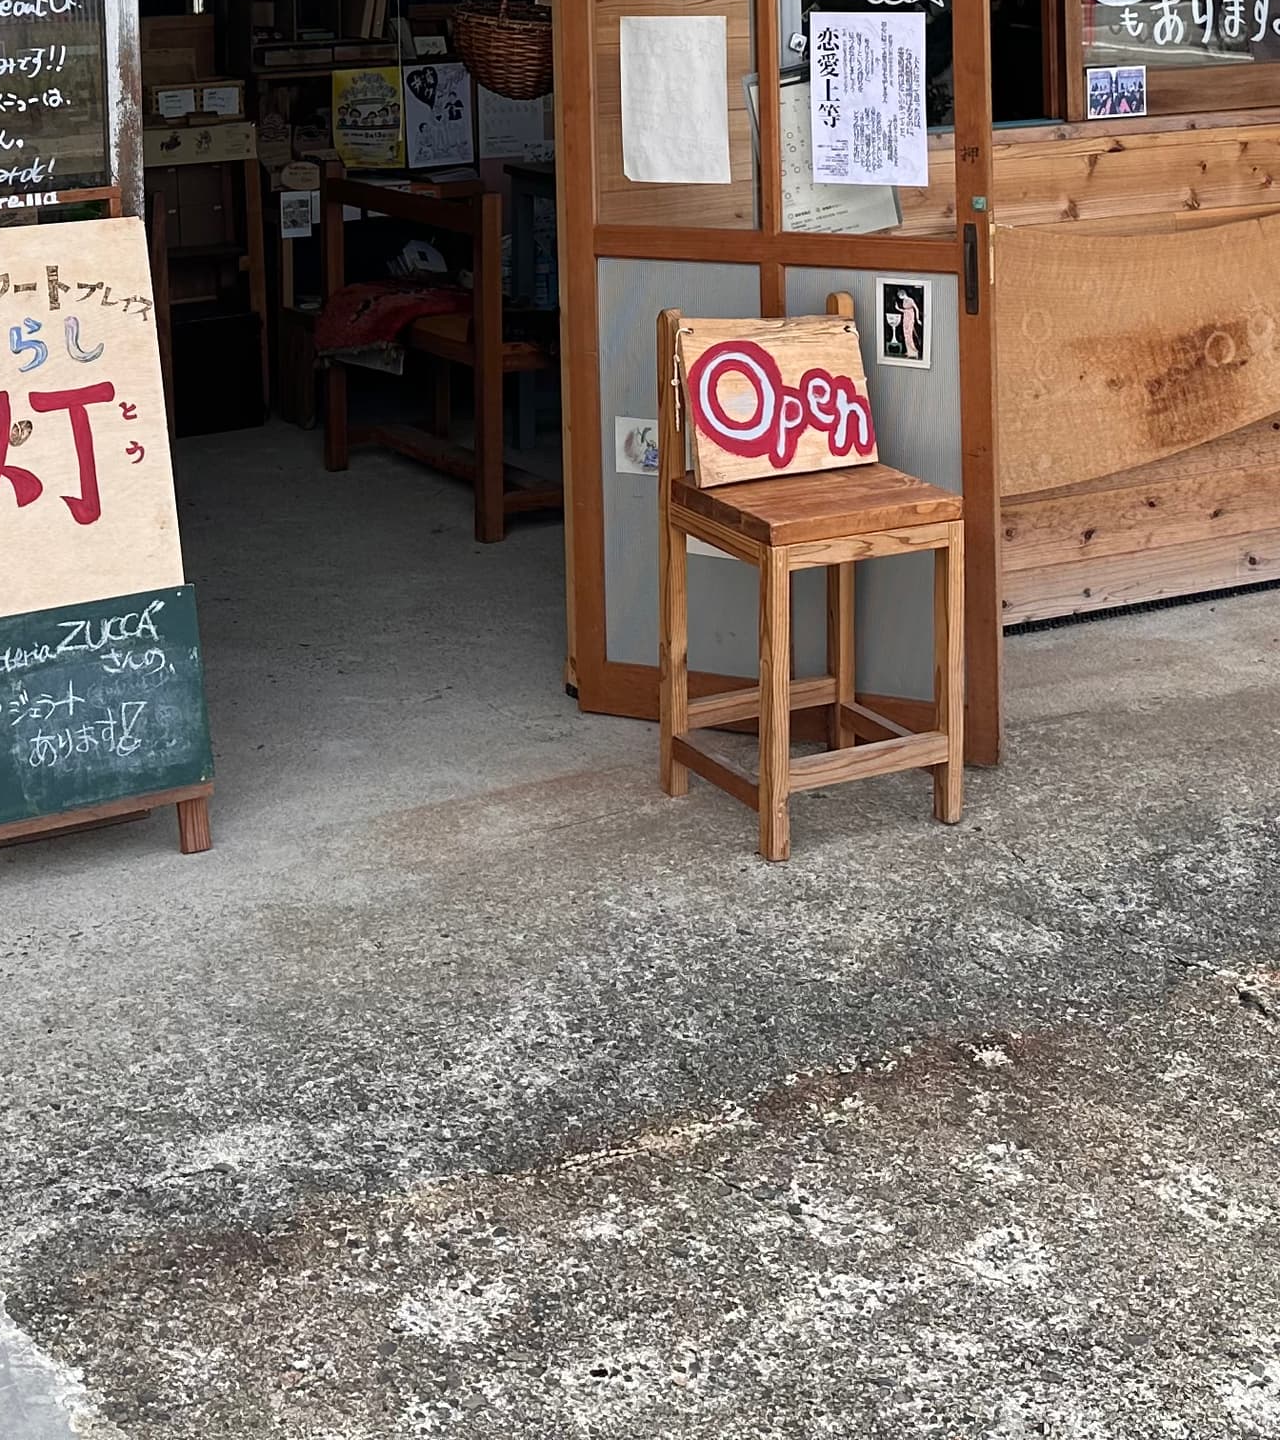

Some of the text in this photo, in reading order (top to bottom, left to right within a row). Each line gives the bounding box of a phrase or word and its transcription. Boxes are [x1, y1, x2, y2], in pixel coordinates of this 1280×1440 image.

[817, 27, 840, 129] 恋愛上等
[960, 146, 979, 164] 押
[118, 402, 145, 464] とう
[696, 348, 871, 461] Open
